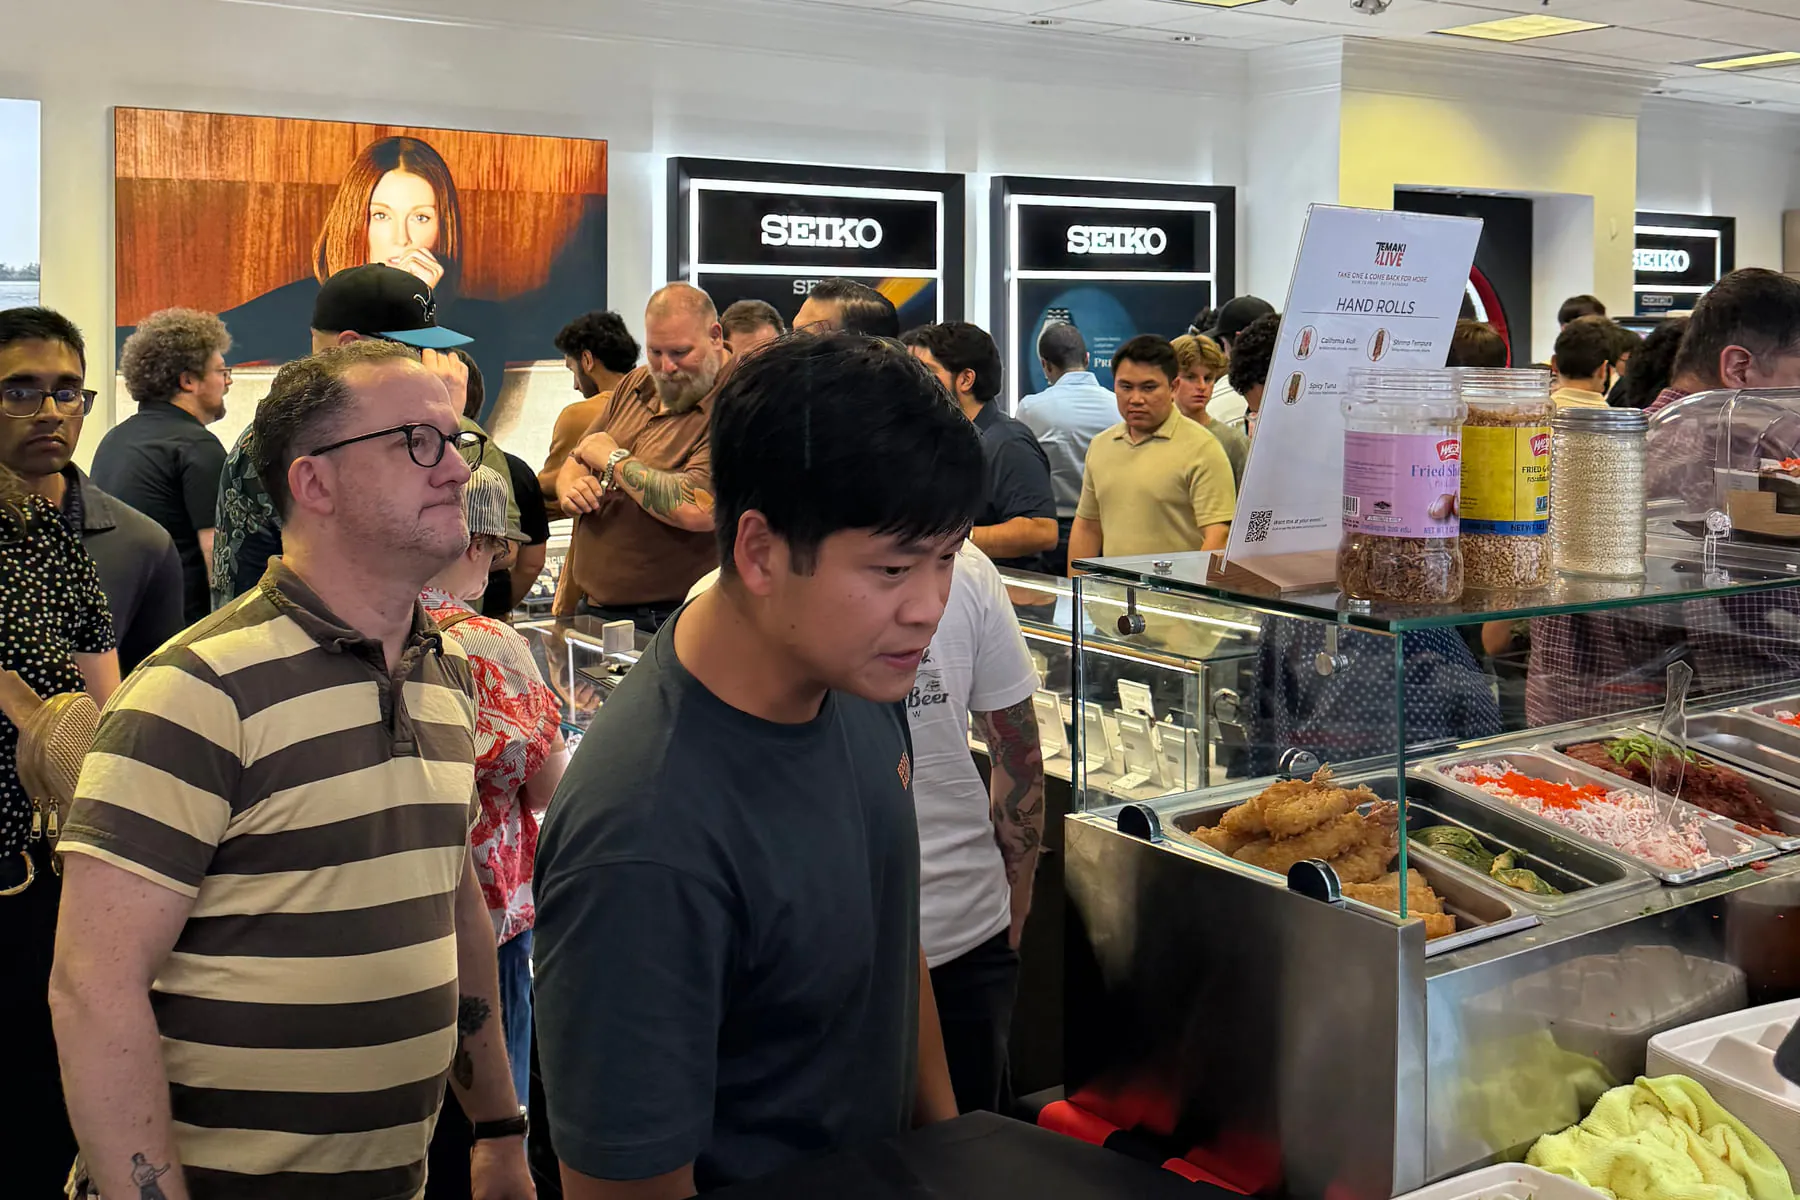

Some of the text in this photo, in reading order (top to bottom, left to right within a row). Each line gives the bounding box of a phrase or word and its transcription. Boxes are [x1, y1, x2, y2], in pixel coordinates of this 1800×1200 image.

[761, 214, 882, 249] SEIKO
[1067, 225, 1167, 255] SEIKO
[1376, 241, 1406, 257] TEMAKI
[1338, 271, 1351, 279] TAKE
[1352, 272, 1364, 280] ONE
[1369, 273, 1385, 281] COME
[1336, 297, 1416, 314] HAND ROLLS
[1309, 382, 1323, 390] Spicy
[1411, 464, 1445, 477] Fried
[1447, 464, 1459, 477] Sh
[1521, 465, 1542, 473] FRIED
[908, 686, 949, 708] Beer
